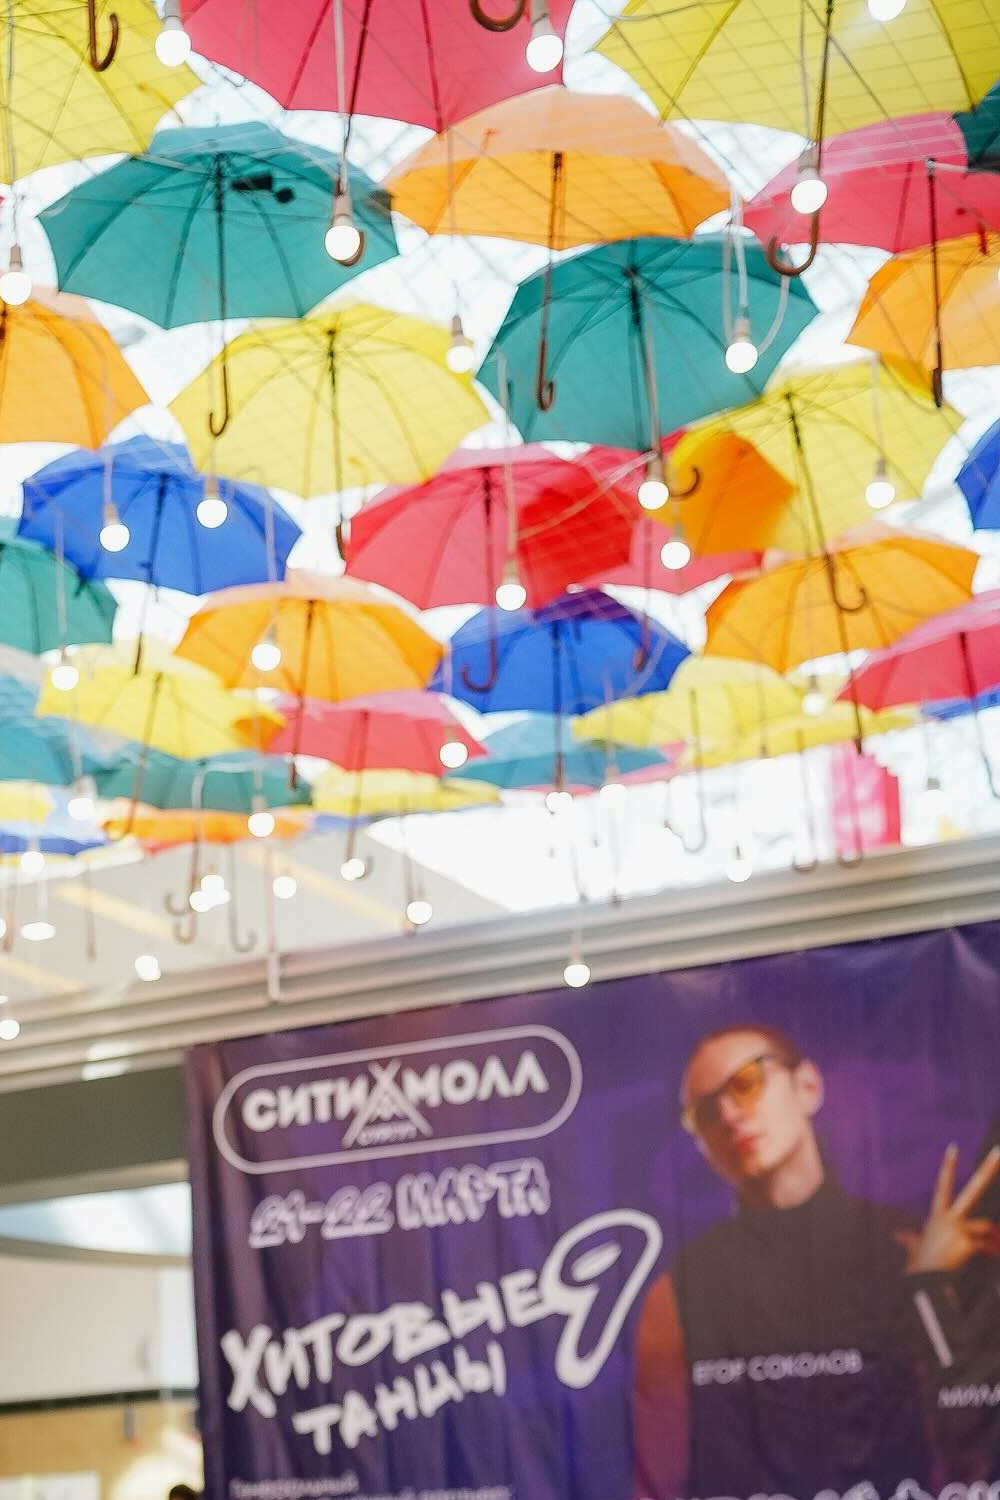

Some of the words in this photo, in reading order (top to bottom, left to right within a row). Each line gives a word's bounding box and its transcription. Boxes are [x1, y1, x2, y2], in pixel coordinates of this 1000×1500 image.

[242, 1074, 371, 1132] СИТИ
[399, 1049, 550, 1108] МОЛЛ
[249, 1181, 395, 1249] 21-22
[396, 1157, 551, 1231] МАРТА
[748, 1348, 863, 1382] СОКОЛОВ
